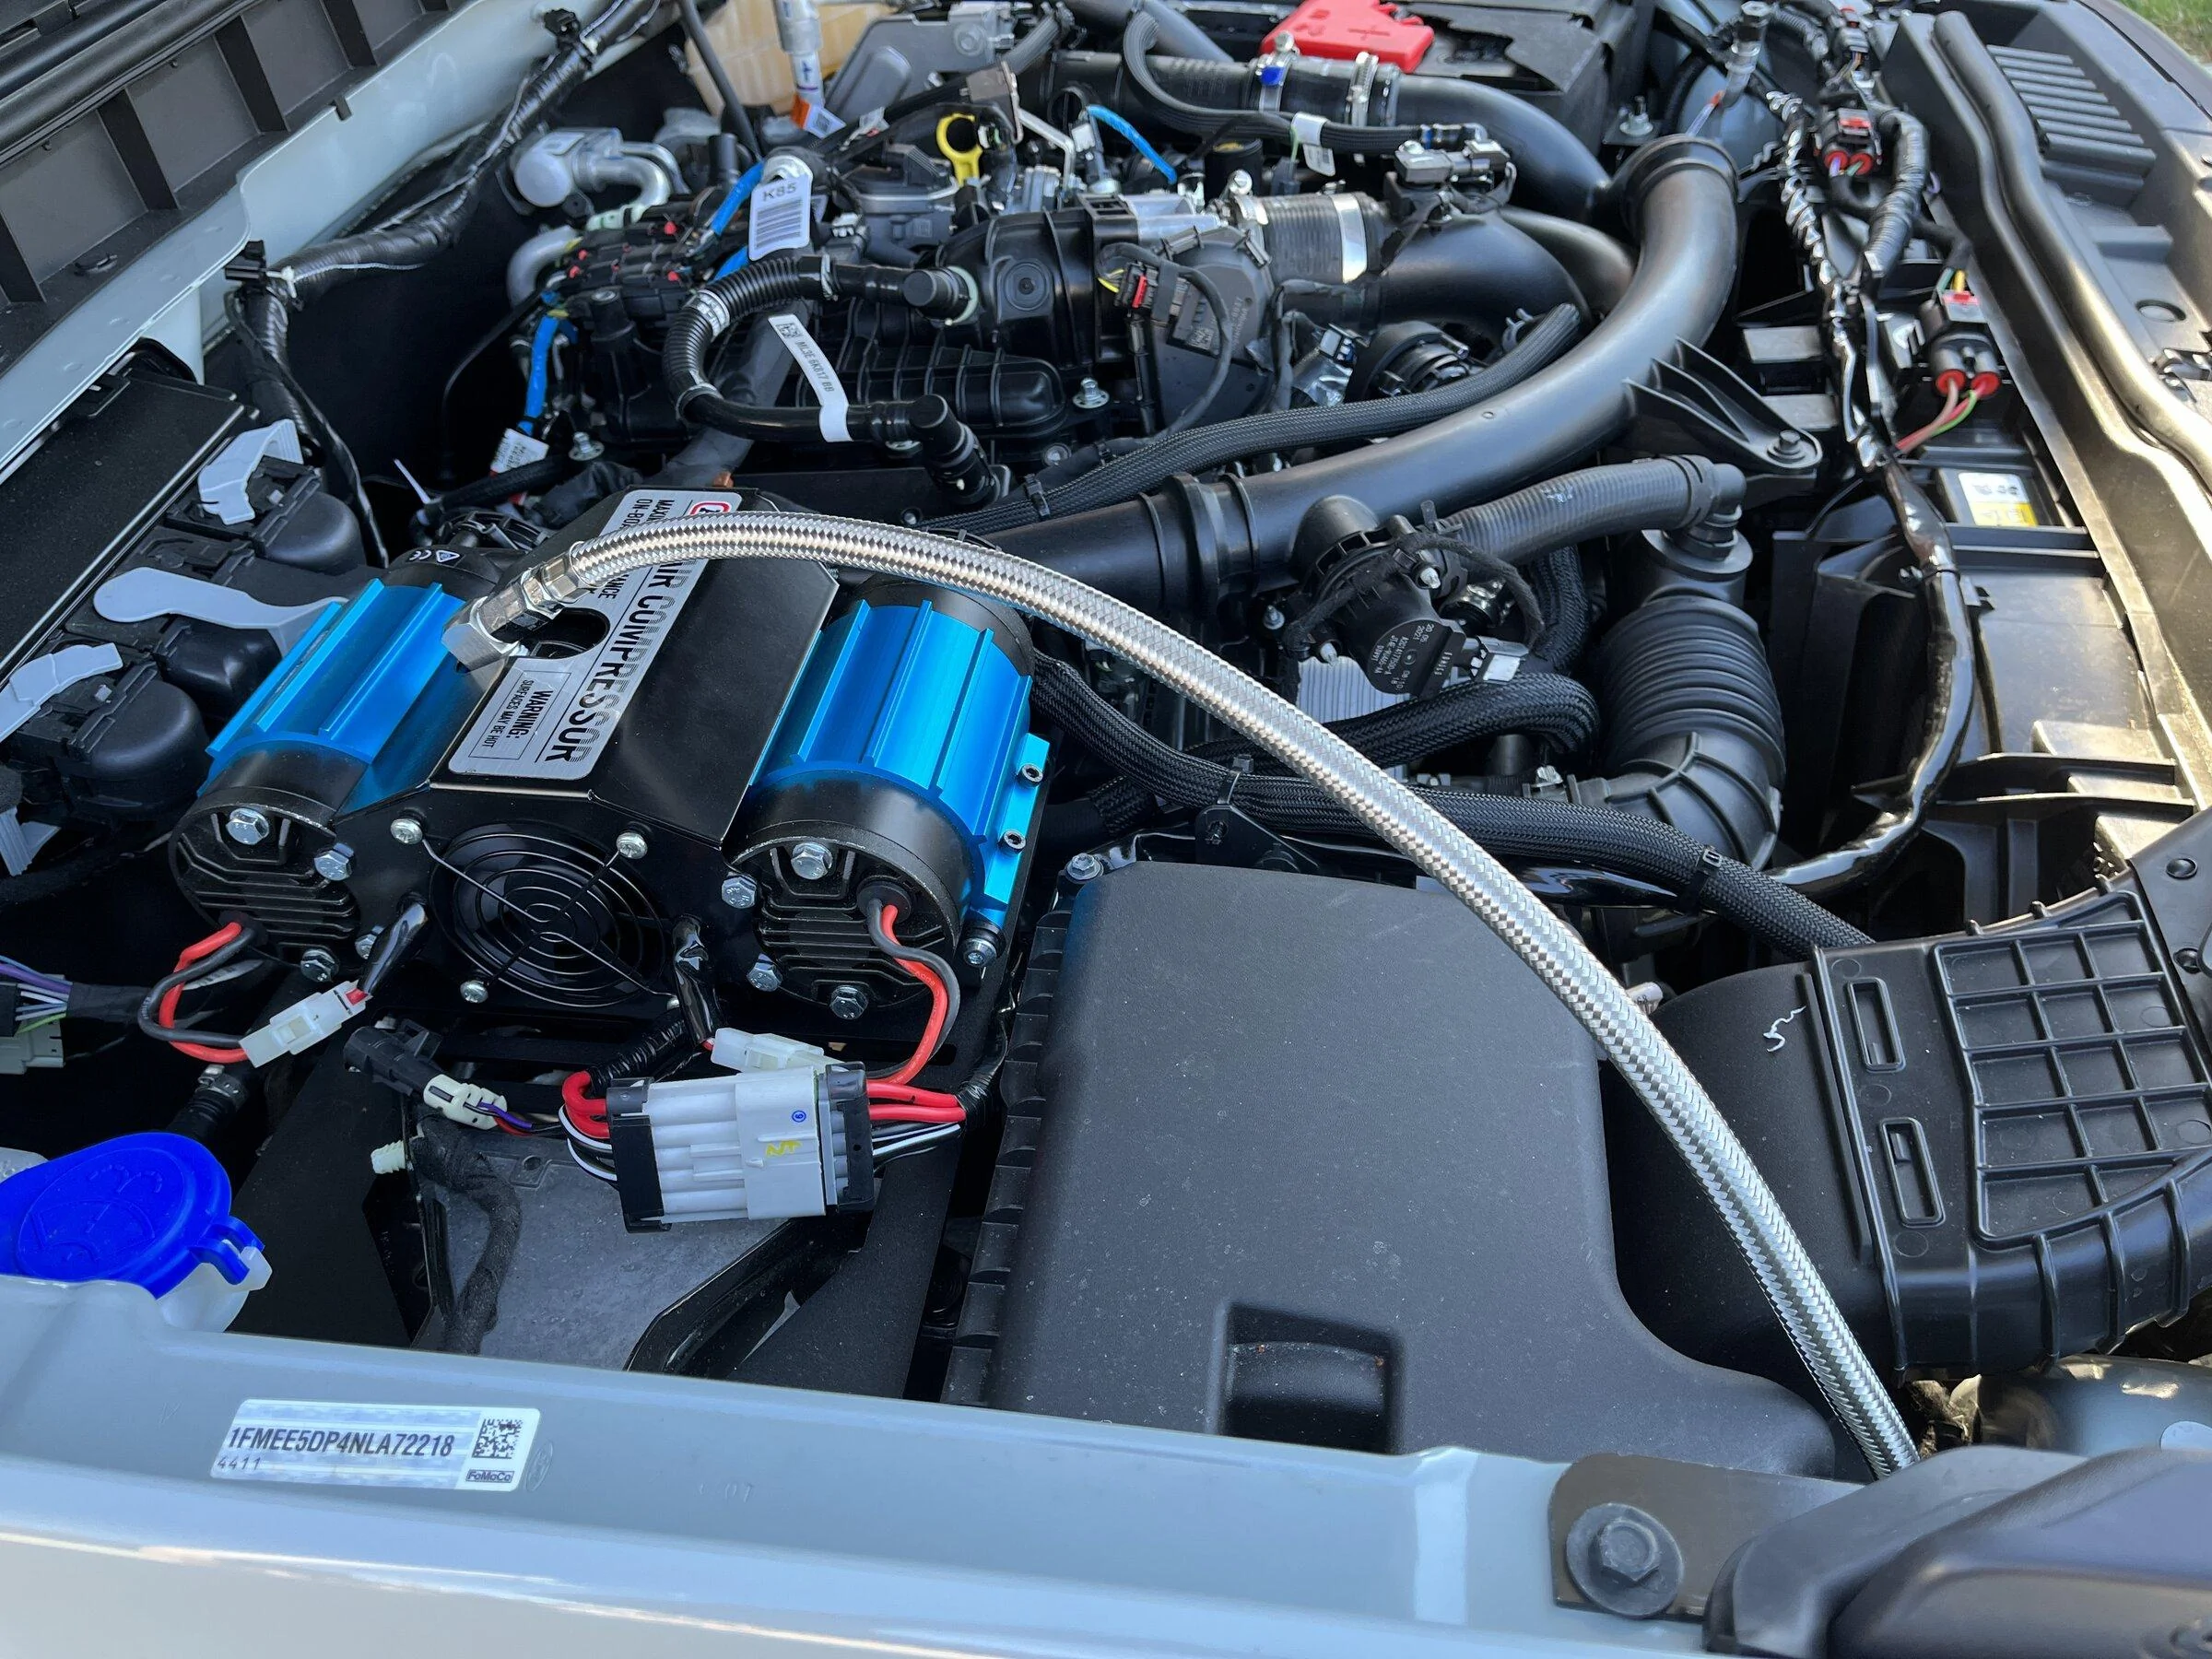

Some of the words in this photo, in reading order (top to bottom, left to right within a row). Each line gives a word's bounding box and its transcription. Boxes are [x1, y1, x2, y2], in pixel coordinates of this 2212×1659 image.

[762, 182, 797, 201] K85
[545, 594, 676, 762] COMPRESSOR
[506, 679, 535, 710] SURFACES
[498, 711, 515, 724] MAY
[506, 690, 554, 738] WARNING:
[490, 725, 505, 734] BE
[482, 735, 500, 748] HOT
[229, 1427, 455, 1458] 1FMEE5DP4NLA72218
[217, 1455, 262, 1471] 4411
[466, 1469, 512, 1483] FoMoCo
